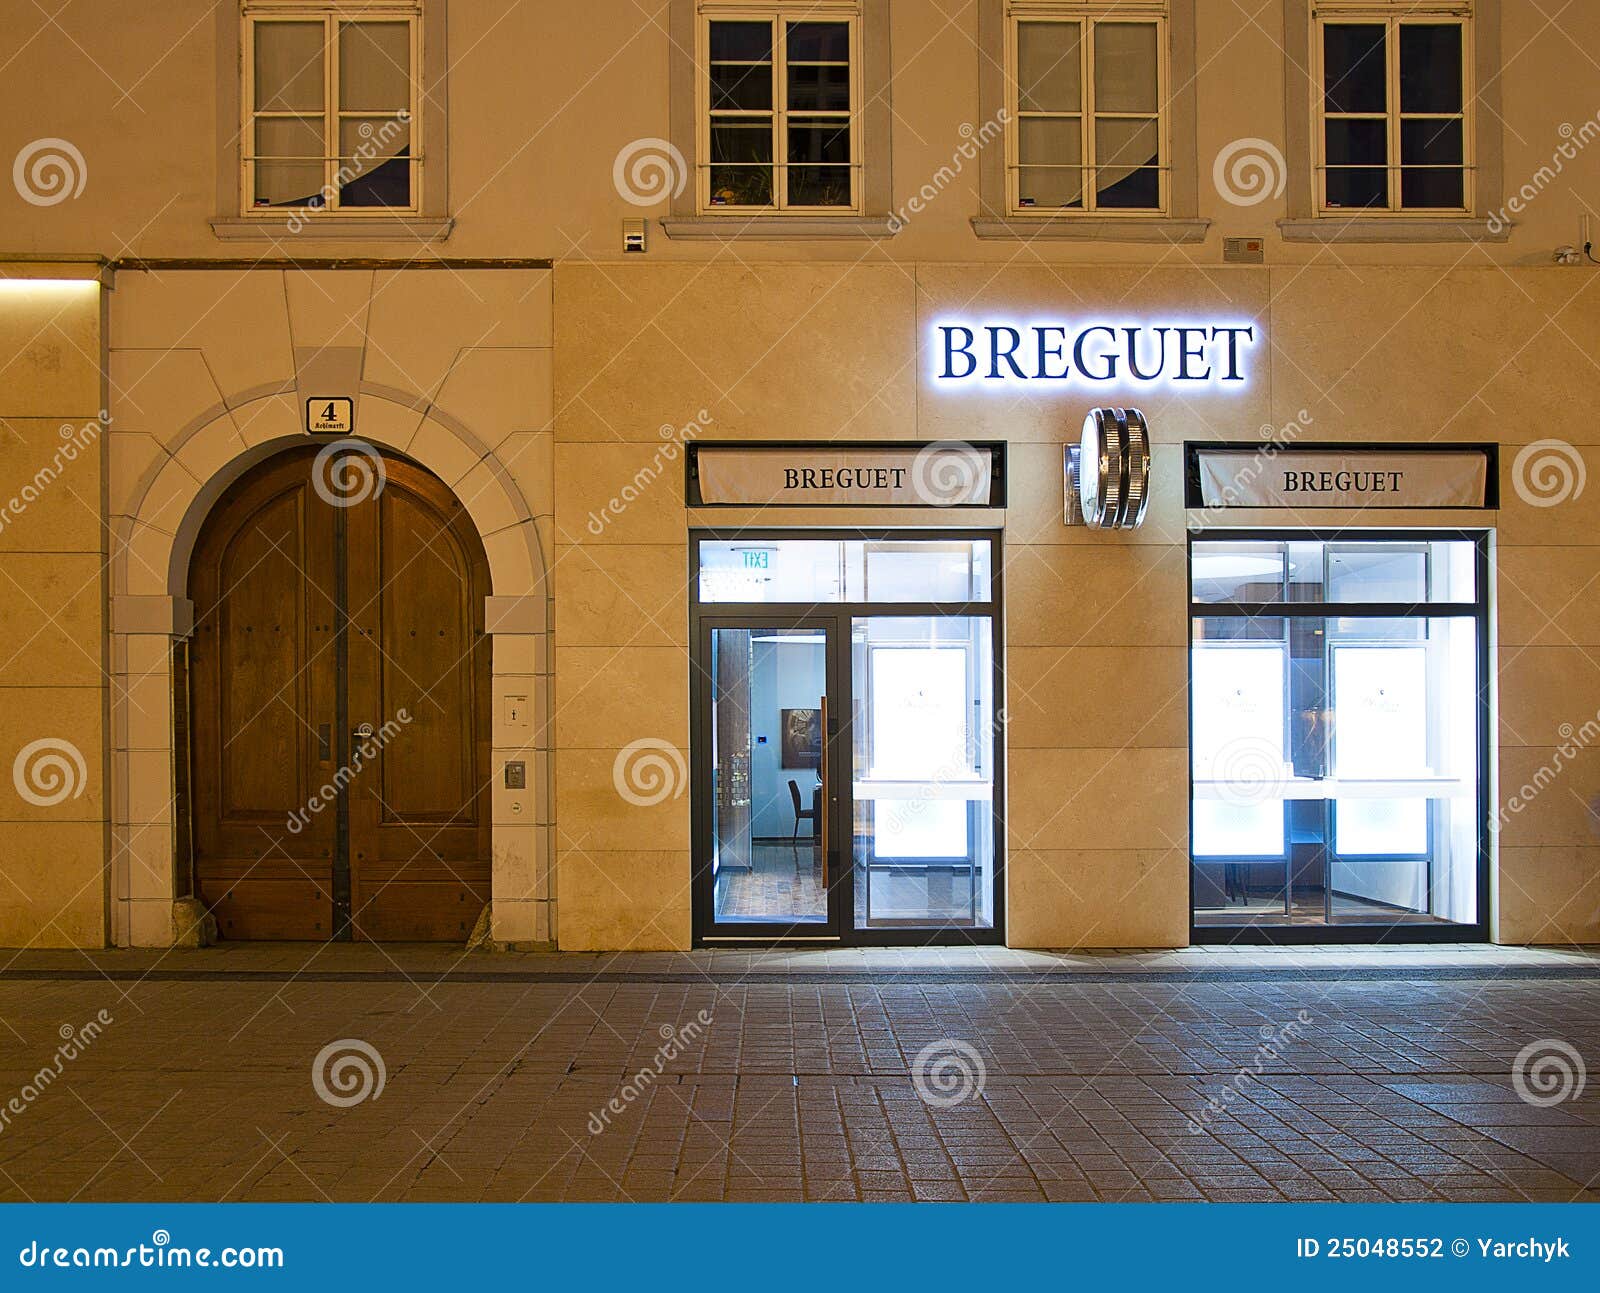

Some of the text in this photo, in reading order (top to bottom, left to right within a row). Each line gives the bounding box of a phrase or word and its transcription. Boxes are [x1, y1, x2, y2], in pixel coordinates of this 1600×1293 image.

[938, 326, 1253, 380] BREGUET
[321, 402, 337, 421] 4
[784, 468, 906, 489] BREGUET
[1283, 471, 1403, 492] BREGUET
